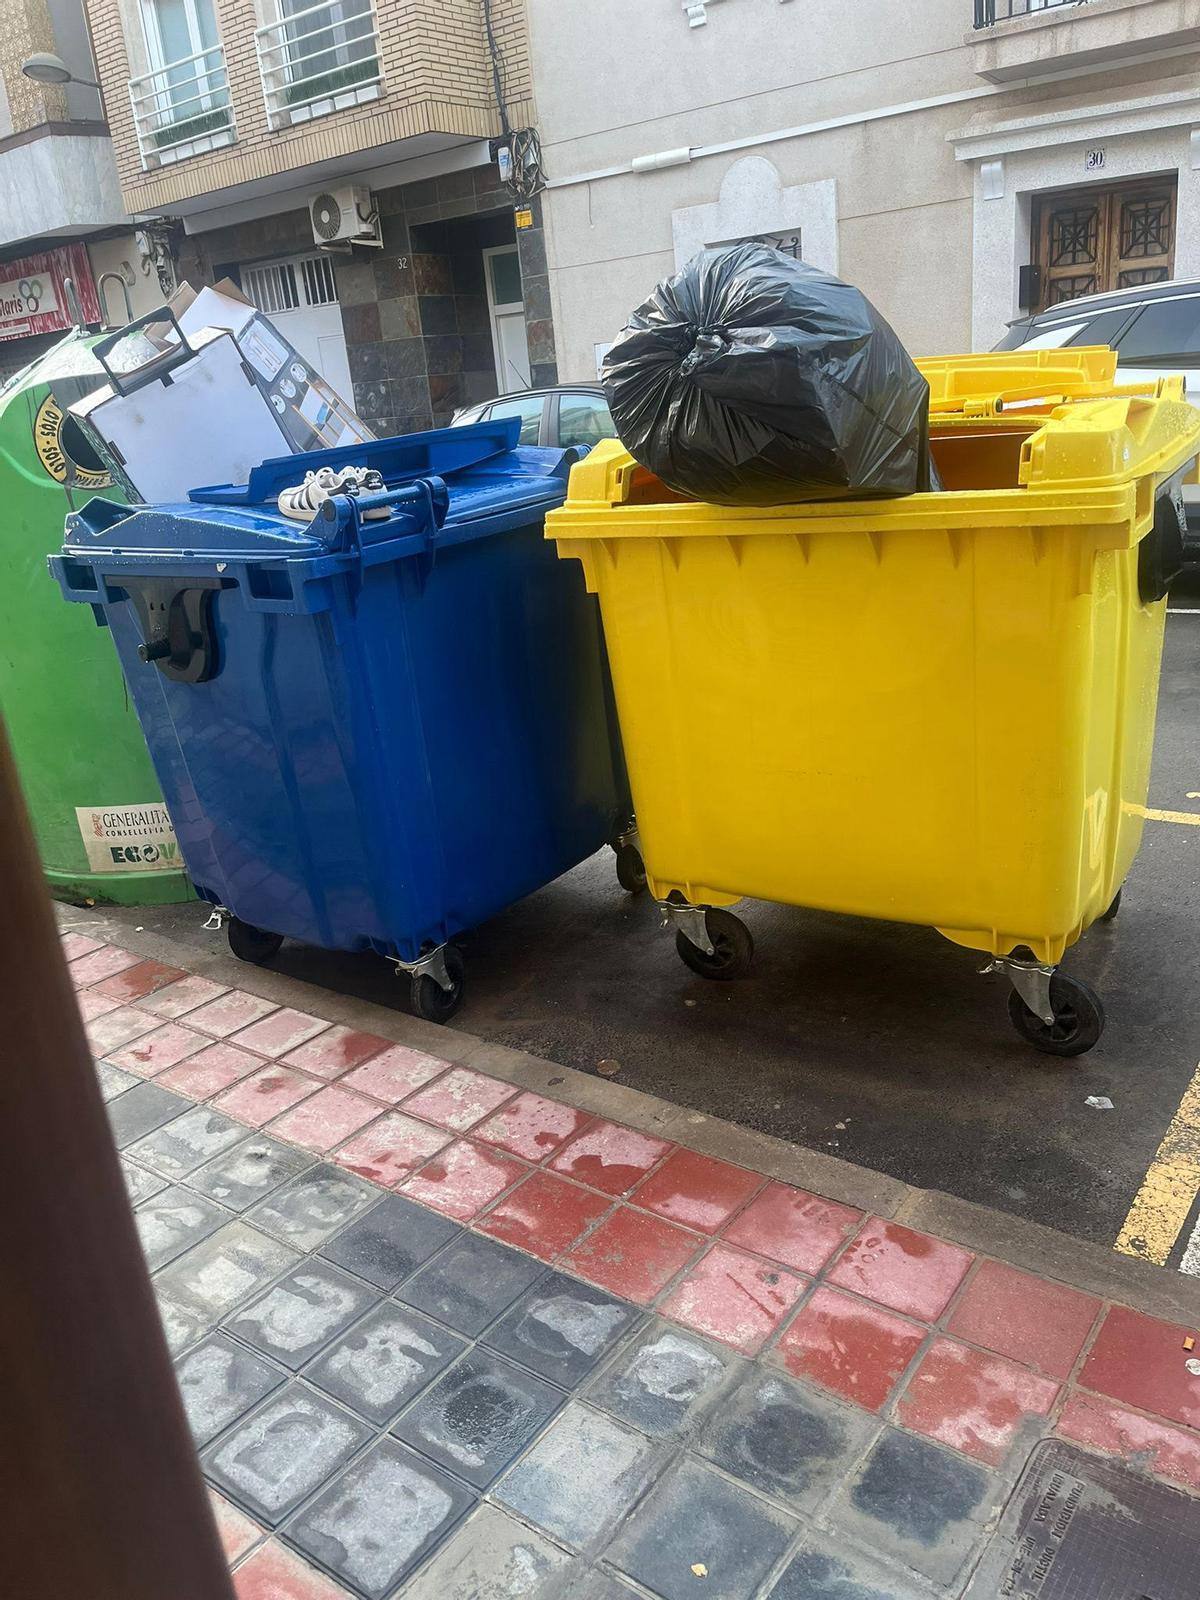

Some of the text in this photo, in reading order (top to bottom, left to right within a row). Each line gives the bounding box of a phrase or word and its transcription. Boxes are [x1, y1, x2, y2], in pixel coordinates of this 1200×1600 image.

[1089, 151, 1103, 166] 30
[397, 257, 408, 270] 32
[102, 810, 170, 829] GENERALITA
[1033, 1472, 1065, 1522] IGUALADA
